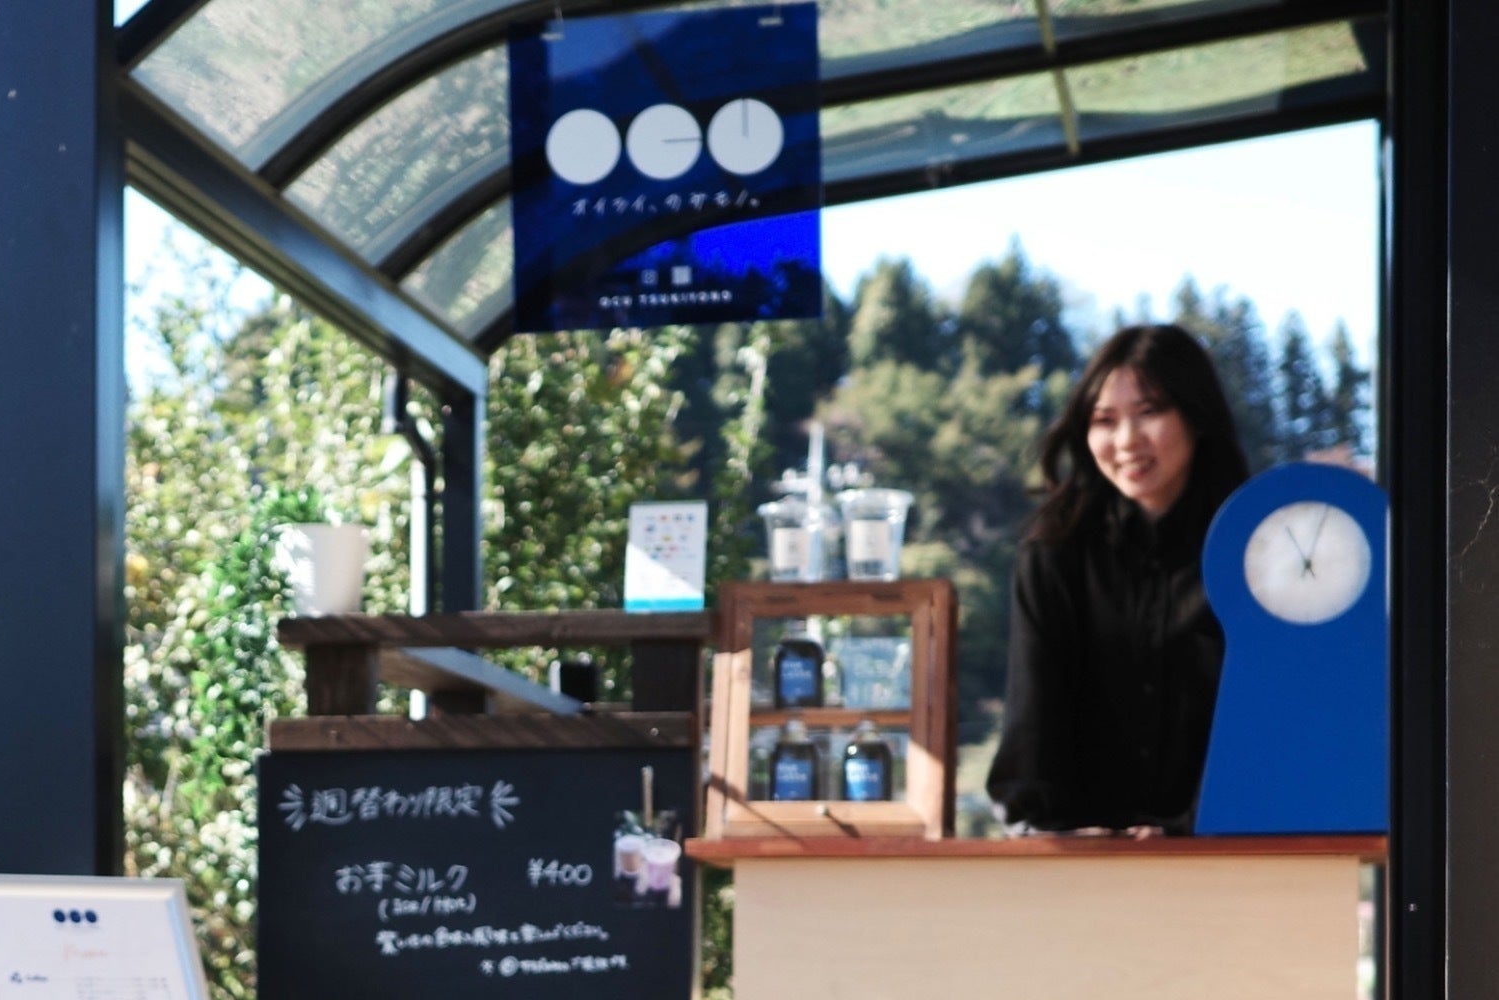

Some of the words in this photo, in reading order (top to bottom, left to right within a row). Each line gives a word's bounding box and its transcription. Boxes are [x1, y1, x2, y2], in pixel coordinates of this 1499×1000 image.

[309, 783, 483, 825] 週替わり限定
[527, 857, 593, 887] ¥400
